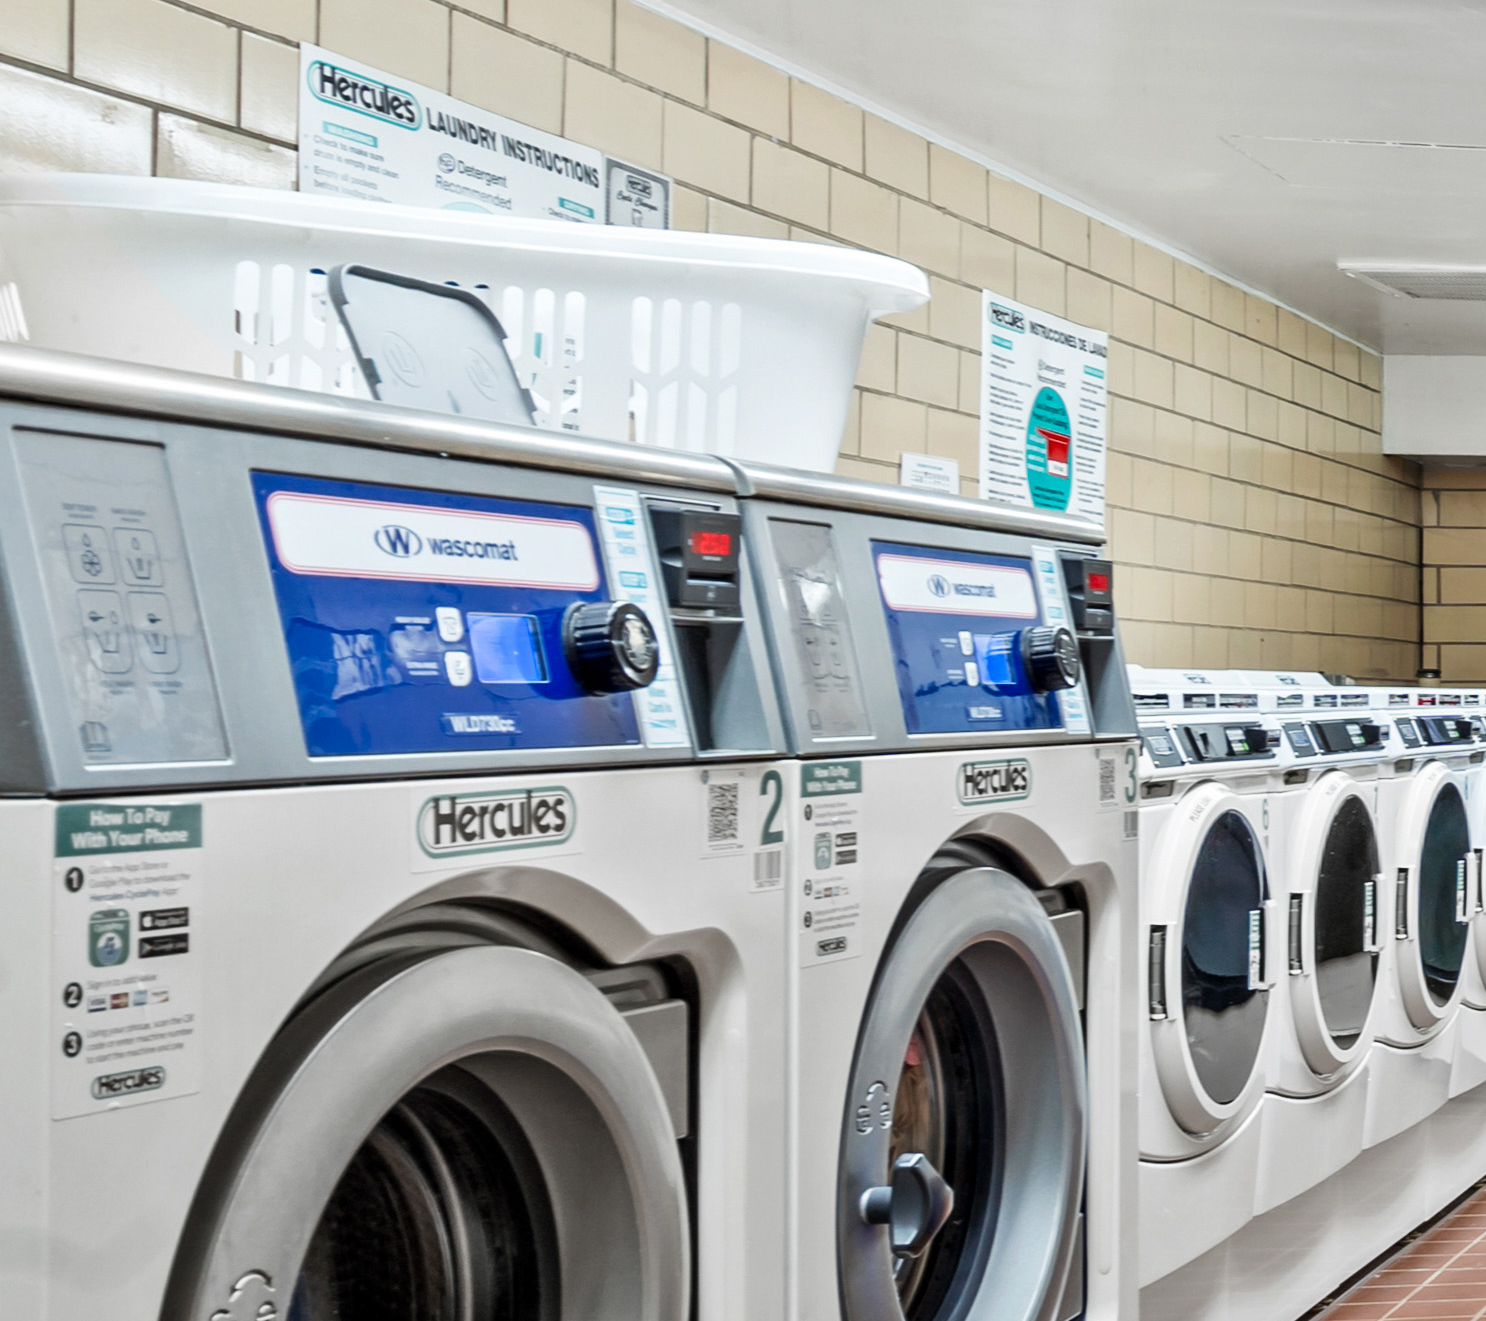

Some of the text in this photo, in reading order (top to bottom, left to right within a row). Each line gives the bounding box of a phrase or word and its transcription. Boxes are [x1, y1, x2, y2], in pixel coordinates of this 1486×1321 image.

[319, 63, 416, 123] Hercules
[426, 107, 600, 189] LAUNDRY INSTRUCTIONS
[457, 160, 508, 189] Detergent
[435, 174, 512, 210] Recommended
[427, 536, 519, 562] wascomat
[953, 582, 997, 599] wascomat
[963, 759, 1028, 797] Hercules
[1124, 748, 1138, 804] 3
[90, 807, 171, 827] How To Pay
[433, 789, 567, 845] Hercules
[759, 770, 784, 846] 2
[1262, 798, 1270, 831] 6
[71, 828, 189, 849] With Your Phone
[97, 1067, 161, 1096] Hercules
